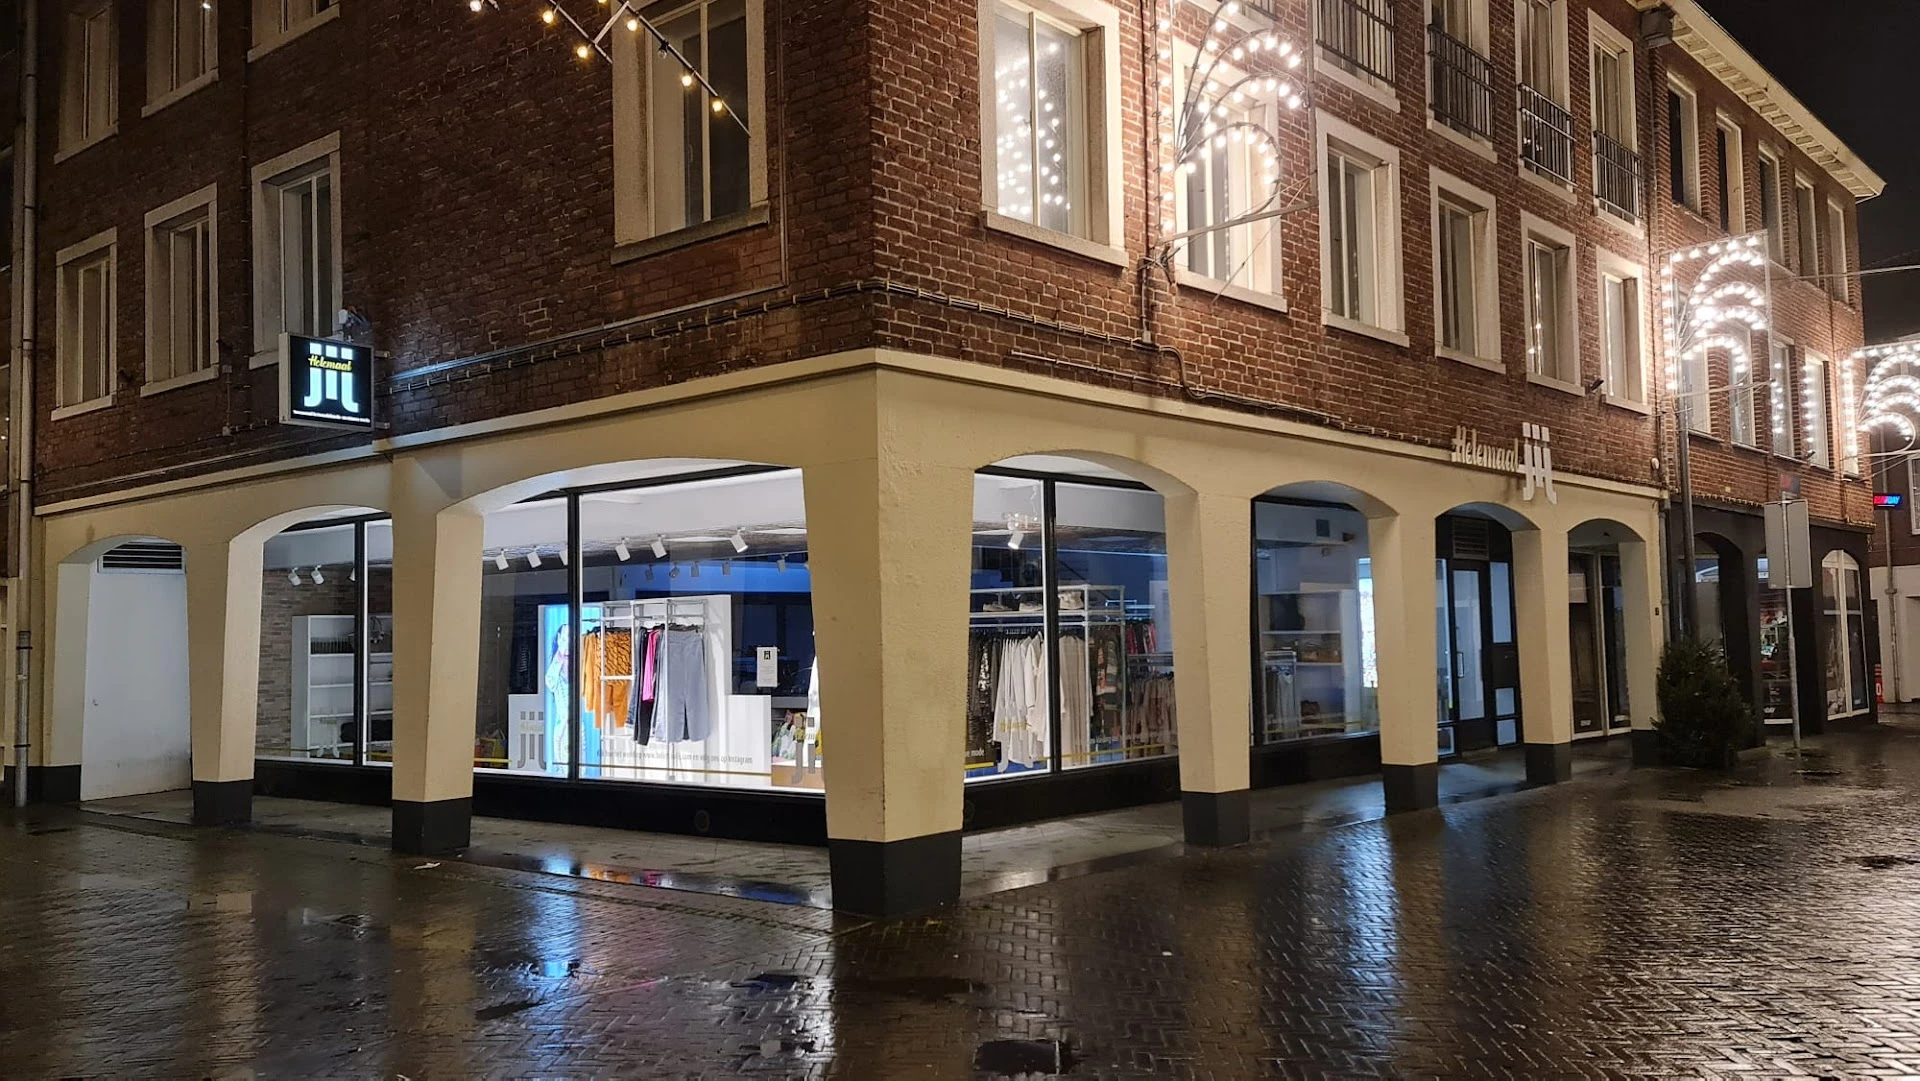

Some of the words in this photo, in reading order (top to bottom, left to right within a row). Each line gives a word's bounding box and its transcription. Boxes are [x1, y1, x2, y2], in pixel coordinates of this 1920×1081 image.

[308, 355, 352, 371] Helemaal
[1451, 424, 1519, 473] Helemaal
[971, 747, 985, 757] mode
